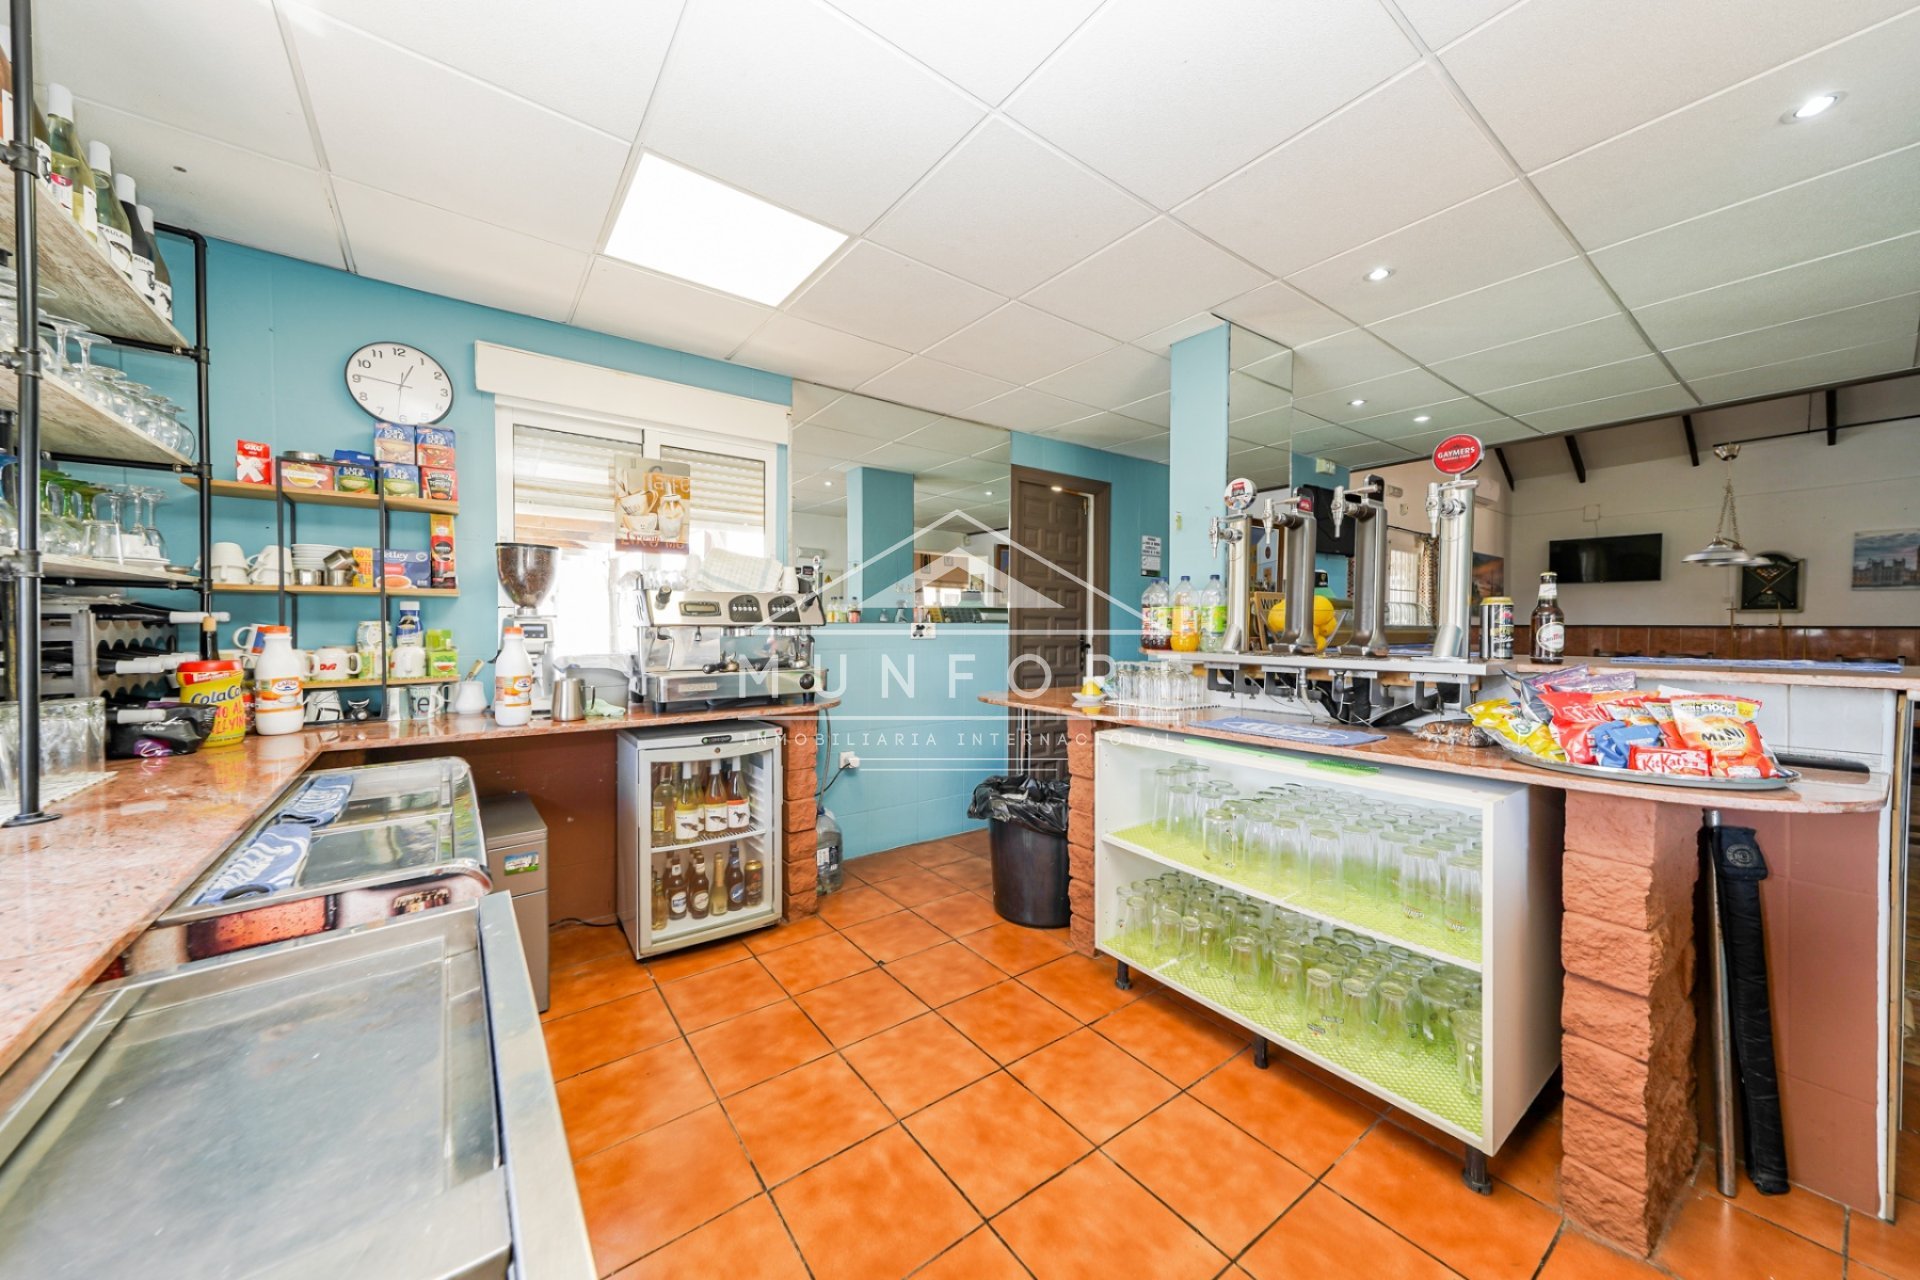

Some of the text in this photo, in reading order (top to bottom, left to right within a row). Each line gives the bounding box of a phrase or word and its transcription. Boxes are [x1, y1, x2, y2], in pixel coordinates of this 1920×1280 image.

[372, 349, 383, 359] 11
[392, 347, 406, 357] 12
[357, 359, 371, 369] 10
[420, 357, 425, 366] 1
[352, 374, 361, 384] 9
[434, 371, 443, 381] 2
[359, 391, 368, 401] 8
[440, 388, 450, 398] 3
[376, 406, 384, 416] 7
[1437, 446, 1475, 460] GAYMERS
[1643, 753, 1684, 773] KitKat
